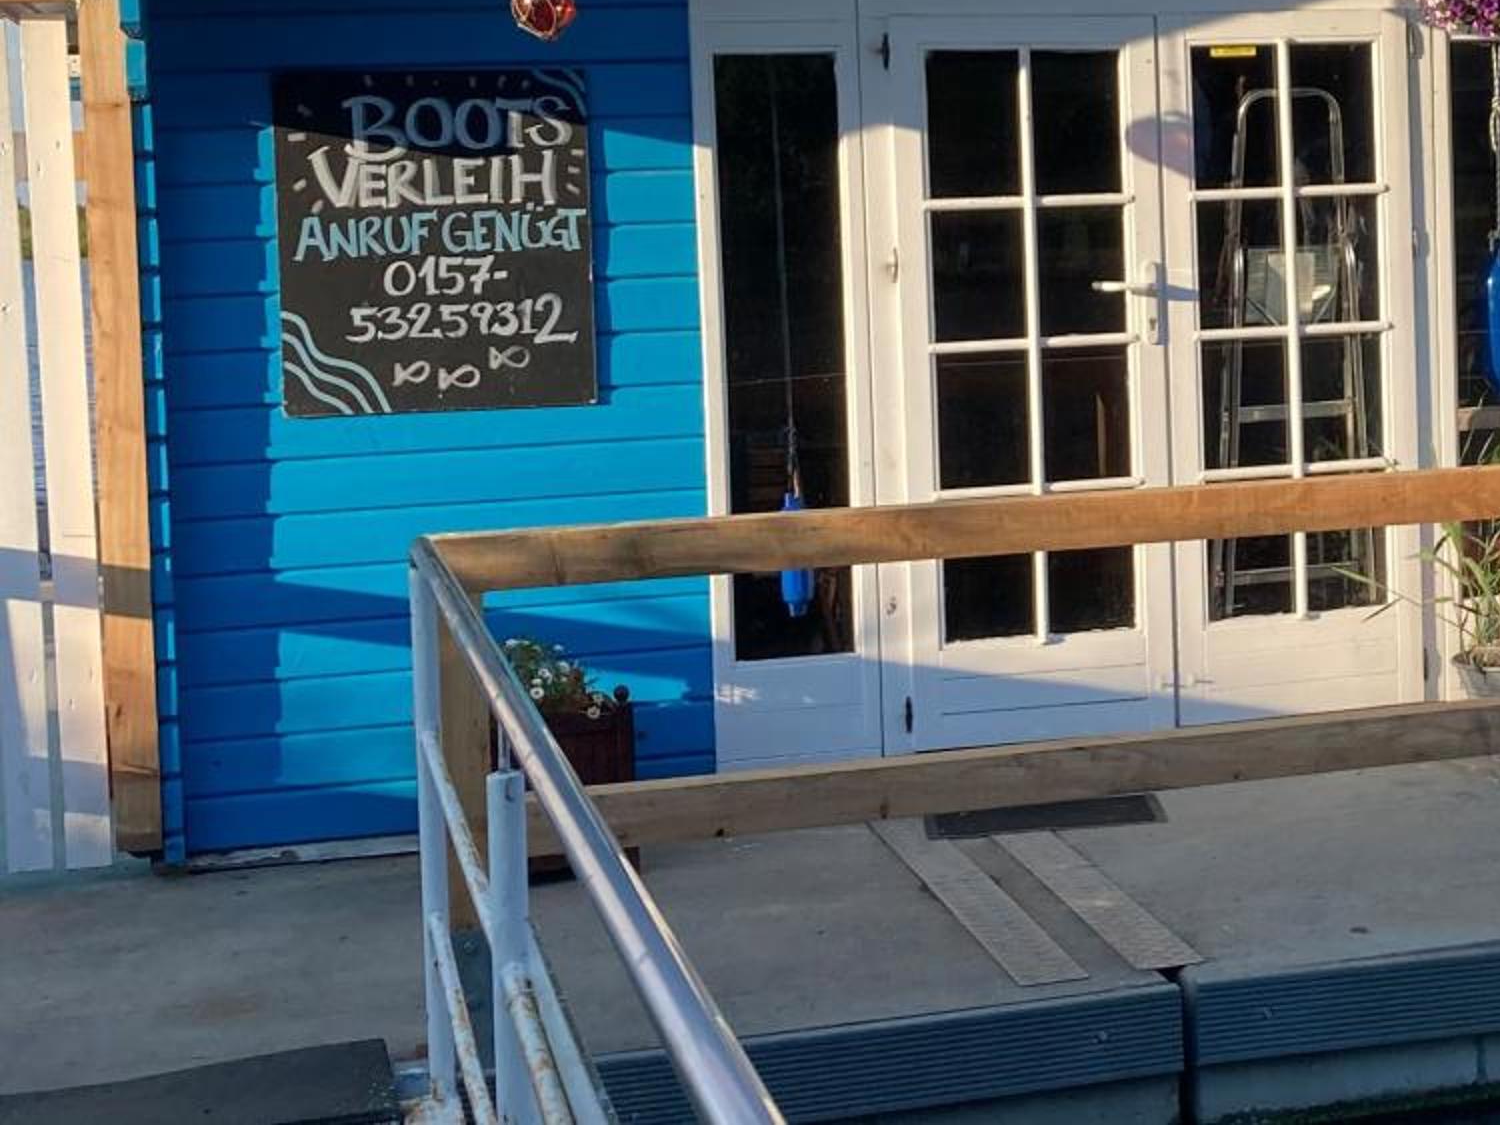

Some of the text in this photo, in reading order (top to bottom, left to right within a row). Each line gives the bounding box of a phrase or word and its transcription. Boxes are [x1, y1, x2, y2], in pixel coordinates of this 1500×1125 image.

[341, 95, 573, 162] BOOTS
[307, 147, 556, 209] VERLEIH
[293, 202, 587, 262] ANRUF GENÜGT
[383, 255, 508, 296] 0157-
[346, 293, 578, 344] 53259312
